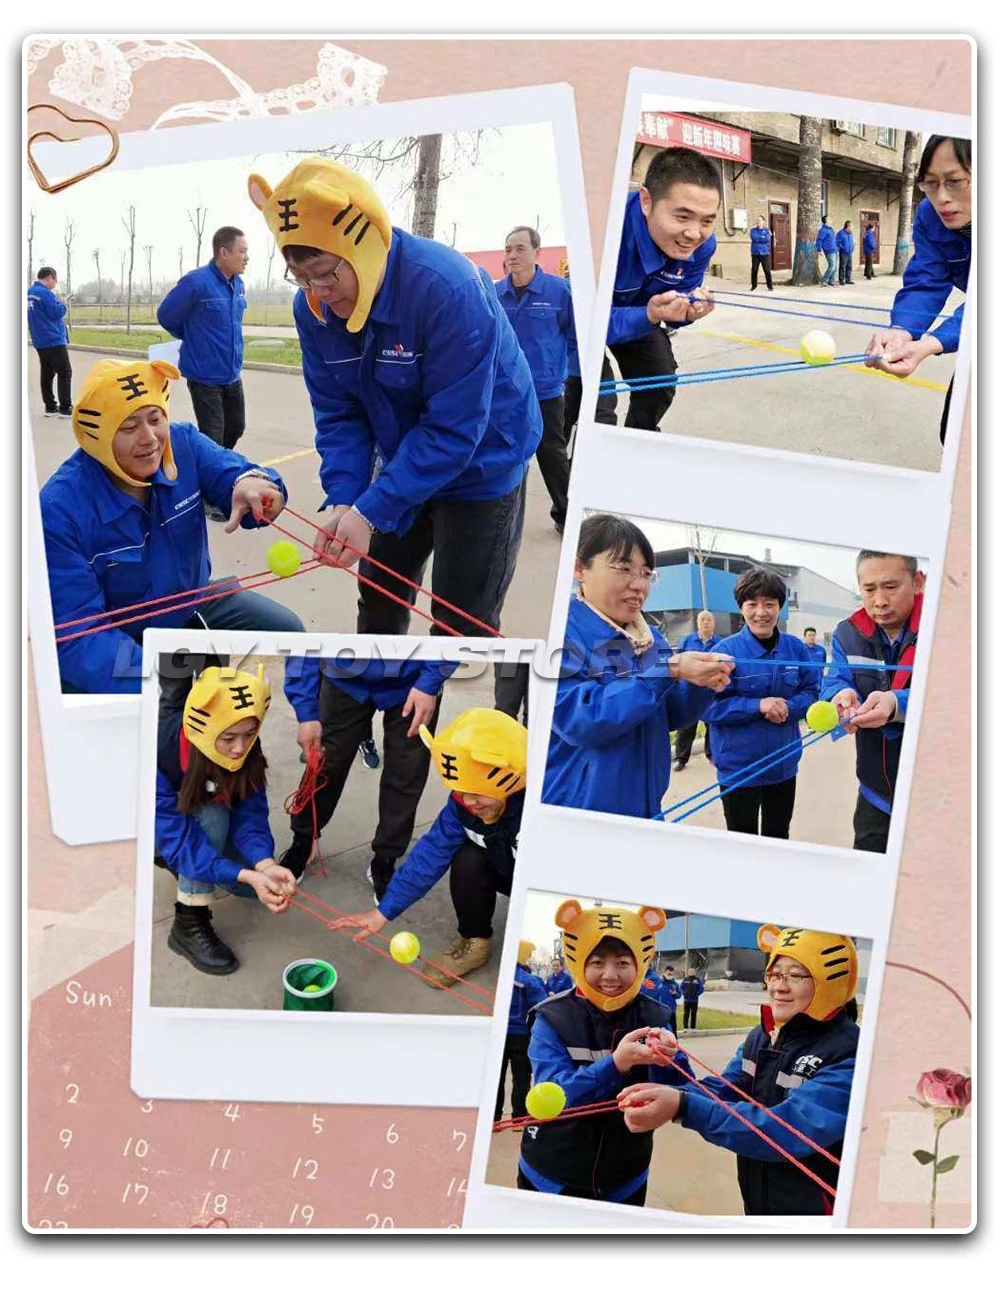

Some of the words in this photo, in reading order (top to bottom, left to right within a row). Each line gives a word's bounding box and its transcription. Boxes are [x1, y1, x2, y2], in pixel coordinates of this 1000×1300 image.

[65, 980, 112, 1008] Sun
[65, 1083, 80, 1104] 2
[140, 1100, 154, 1114] 3
[225, 1104, 241, 1123] 4
[312, 1114, 324, 1134] 5
[386, 1123, 399, 1144] 6
[452, 1129, 467, 1152] 7
[59, 1128, 73, 1150] 9
[123, 1137, 148, 1158] 10
[209, 1148, 232, 1171] 11
[292, 1158, 319, 1180] 12
[369, 1168, 396, 1190] 13
[43, 1173, 70, 1196] 16
[122, 1183, 149, 1205] 17
[201, 1192, 228, 1216] 18
[289, 1204, 315, 1226] 19
